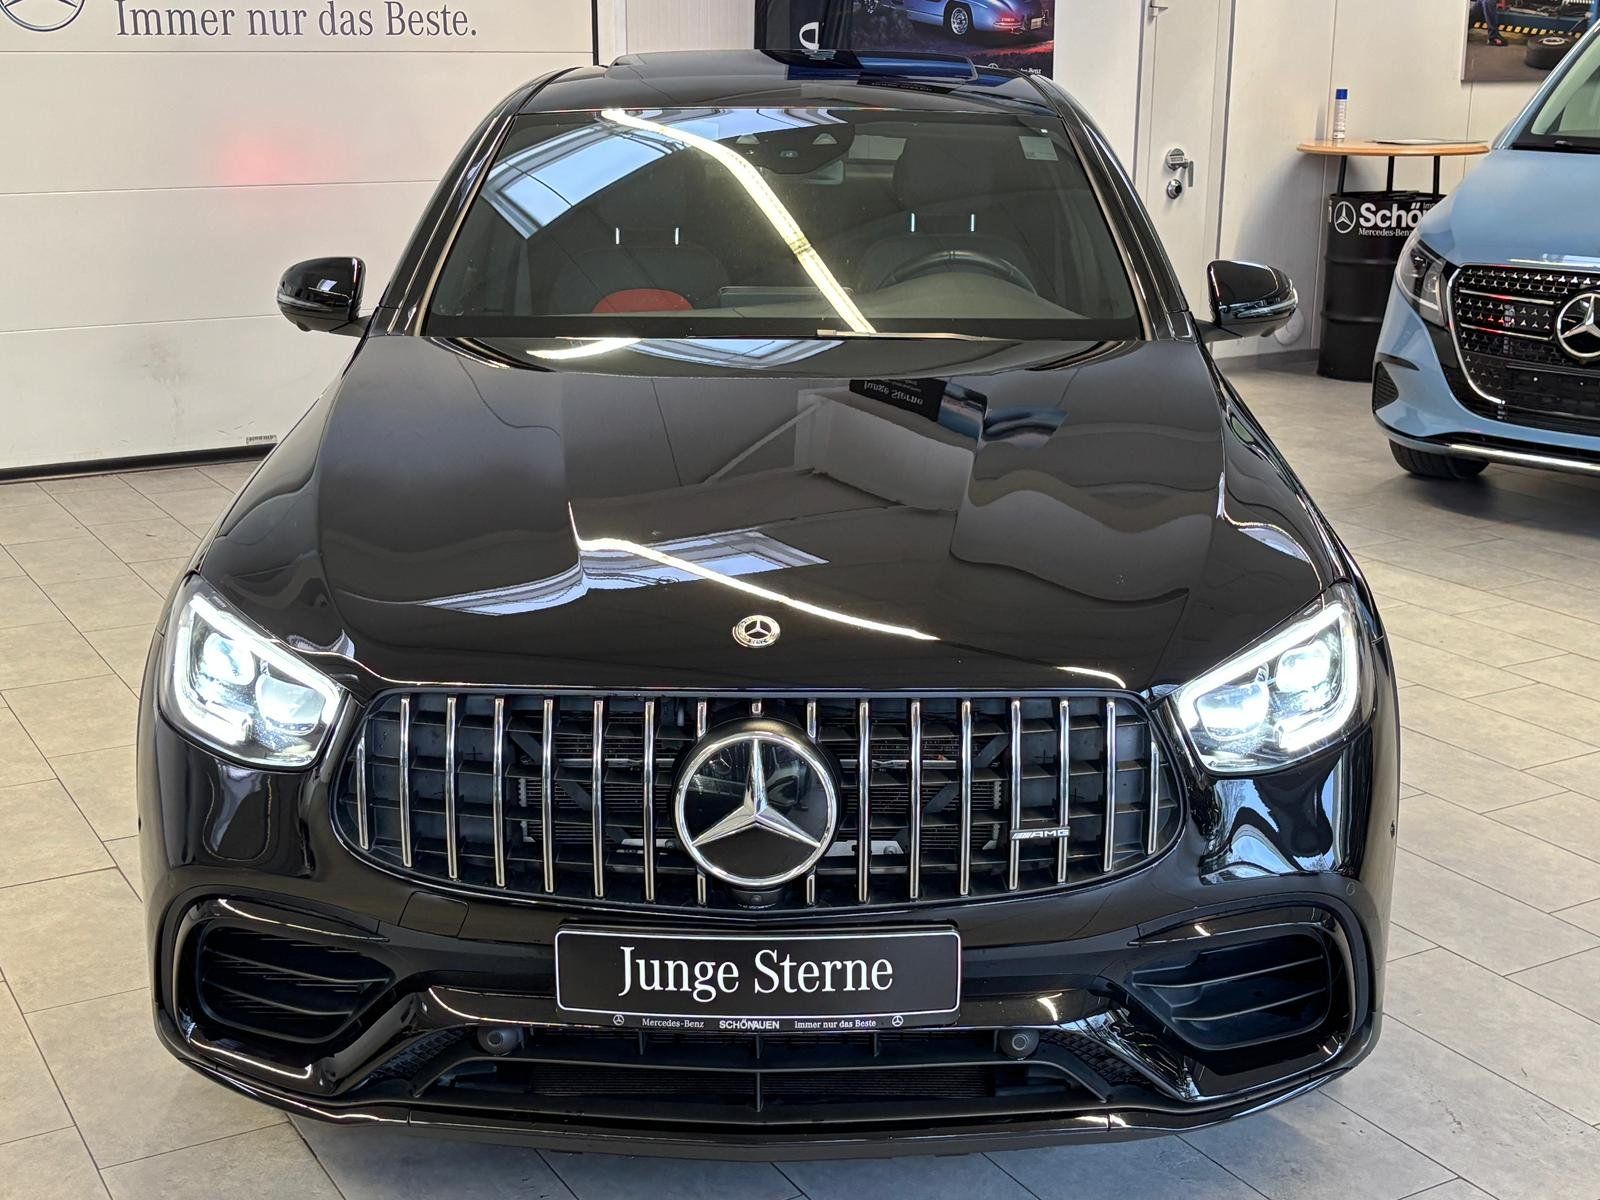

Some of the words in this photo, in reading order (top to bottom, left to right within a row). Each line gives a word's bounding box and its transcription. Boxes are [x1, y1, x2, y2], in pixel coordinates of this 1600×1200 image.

[114, 0, 235, 36] Immer
[247, 9, 307, 36] nur
[318, 1, 374, 36] das
[384, 1, 477, 36] Beste.
[618, 945, 740, 1003] Junge
[754, 949, 894, 995] Sterne
[642, 1018, 705, 1029] Mercedes-Benz
[719, 1018, 780, 1030] SCHÖNAUEN
[794, 1020, 821, 1029] Immer
[823, 1021, 837, 1029] nur
[839, 1019, 853, 1028] das
[855, 1019, 877, 1028] Beste
